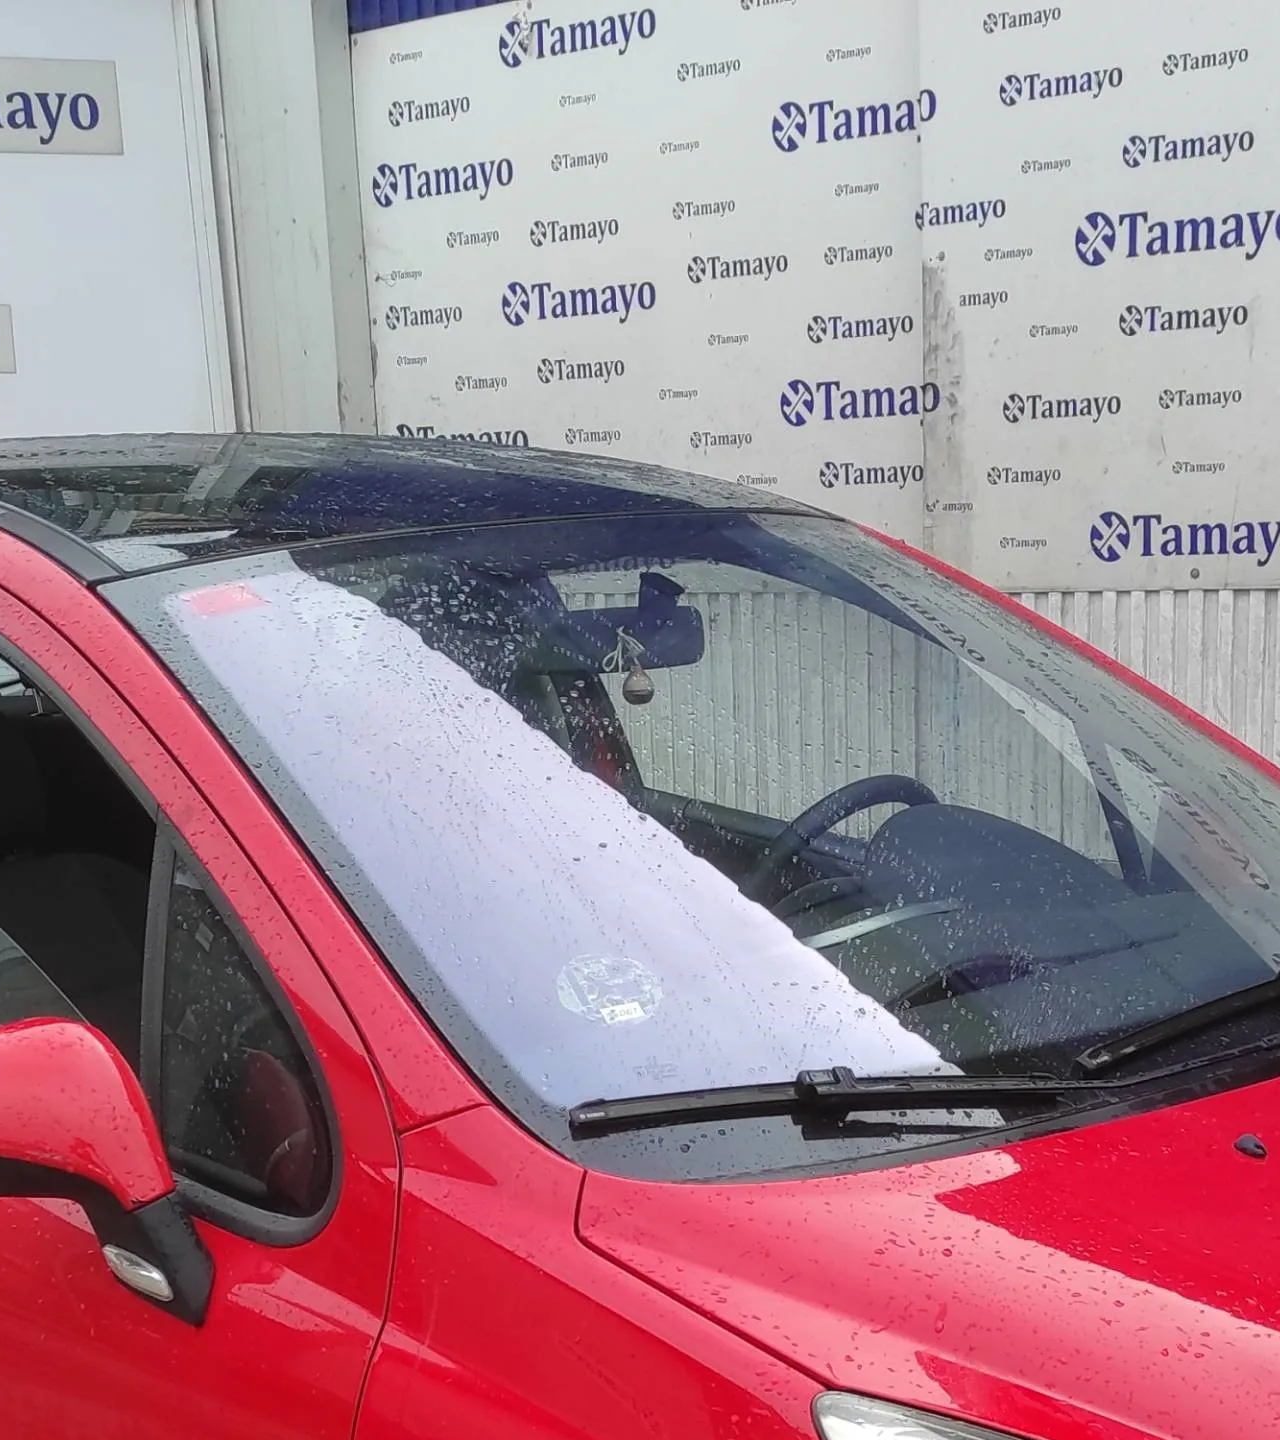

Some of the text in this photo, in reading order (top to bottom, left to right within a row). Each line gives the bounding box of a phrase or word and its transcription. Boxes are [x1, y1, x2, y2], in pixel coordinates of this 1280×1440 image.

[999, 8, 1061, 29] Tamayo
[529, 9, 655, 59] Tamayo
[397, 51, 423, 64] Tamayo
[835, 47, 871, 60] Tamayo
[1180, 49, 1248, 71] Tamayo
[690, 59, 740, 78] Tamayo
[1024, 68, 1122, 100] Tamayo
[567, 94, 597, 106] Tamayo
[404, 97, 470, 122] Tamayo
[809, 89, 936, 143] Tamao
[668, 141, 699, 153] Tamayo
[1149, 131, 1254, 162] Tamayo
[562, 152, 608, 168] Tamayo
[1031, 159, 1071, 172] Tamayo
[399, 159, 513, 200] Tamayo
[843, 183, 880, 195] Tamayo
[685, 200, 735, 217] Tamayo
[457, 231, 499, 246] Tamayo
[547, 219, 618, 244] Tamayo
[838, 246, 892, 263] Tamayo
[994, 248, 1033, 260] Tamayo
[397, 271, 423, 281] Tamayo
[707, 255, 788, 280] Tamayo
[531, 282, 655, 324] Tamayo
[960, 291, 1008, 308] amayo
[400, 306, 462, 328] Tamayo
[1144, 306, 1248, 334] Tamayo
[828, 316, 913, 341] Tamayo
[1040, 325, 1079, 338] Tamayo
[716, 335, 748, 345] Tamayo
[554, 359, 624, 383] Tamayo
[465, 376, 507, 392] Tamayo
[667, 389, 699, 401] Tamayo
[816, 381, 940, 426] Tamao
[1175, 390, 1241, 408] Tamayo
[1027, 395, 1121, 423] Tamayo
[577, 431, 621, 446] Tamayo
[702, 432, 752, 448] Tamayo
[840, 463, 925, 489] Tamayo
[1183, 462, 1225, 474] Tamayo
[746, 475, 777, 486] Tamayo
[1002, 468, 1061, 486] Tamayo
[1009, 537, 1048, 551] Tamayo
